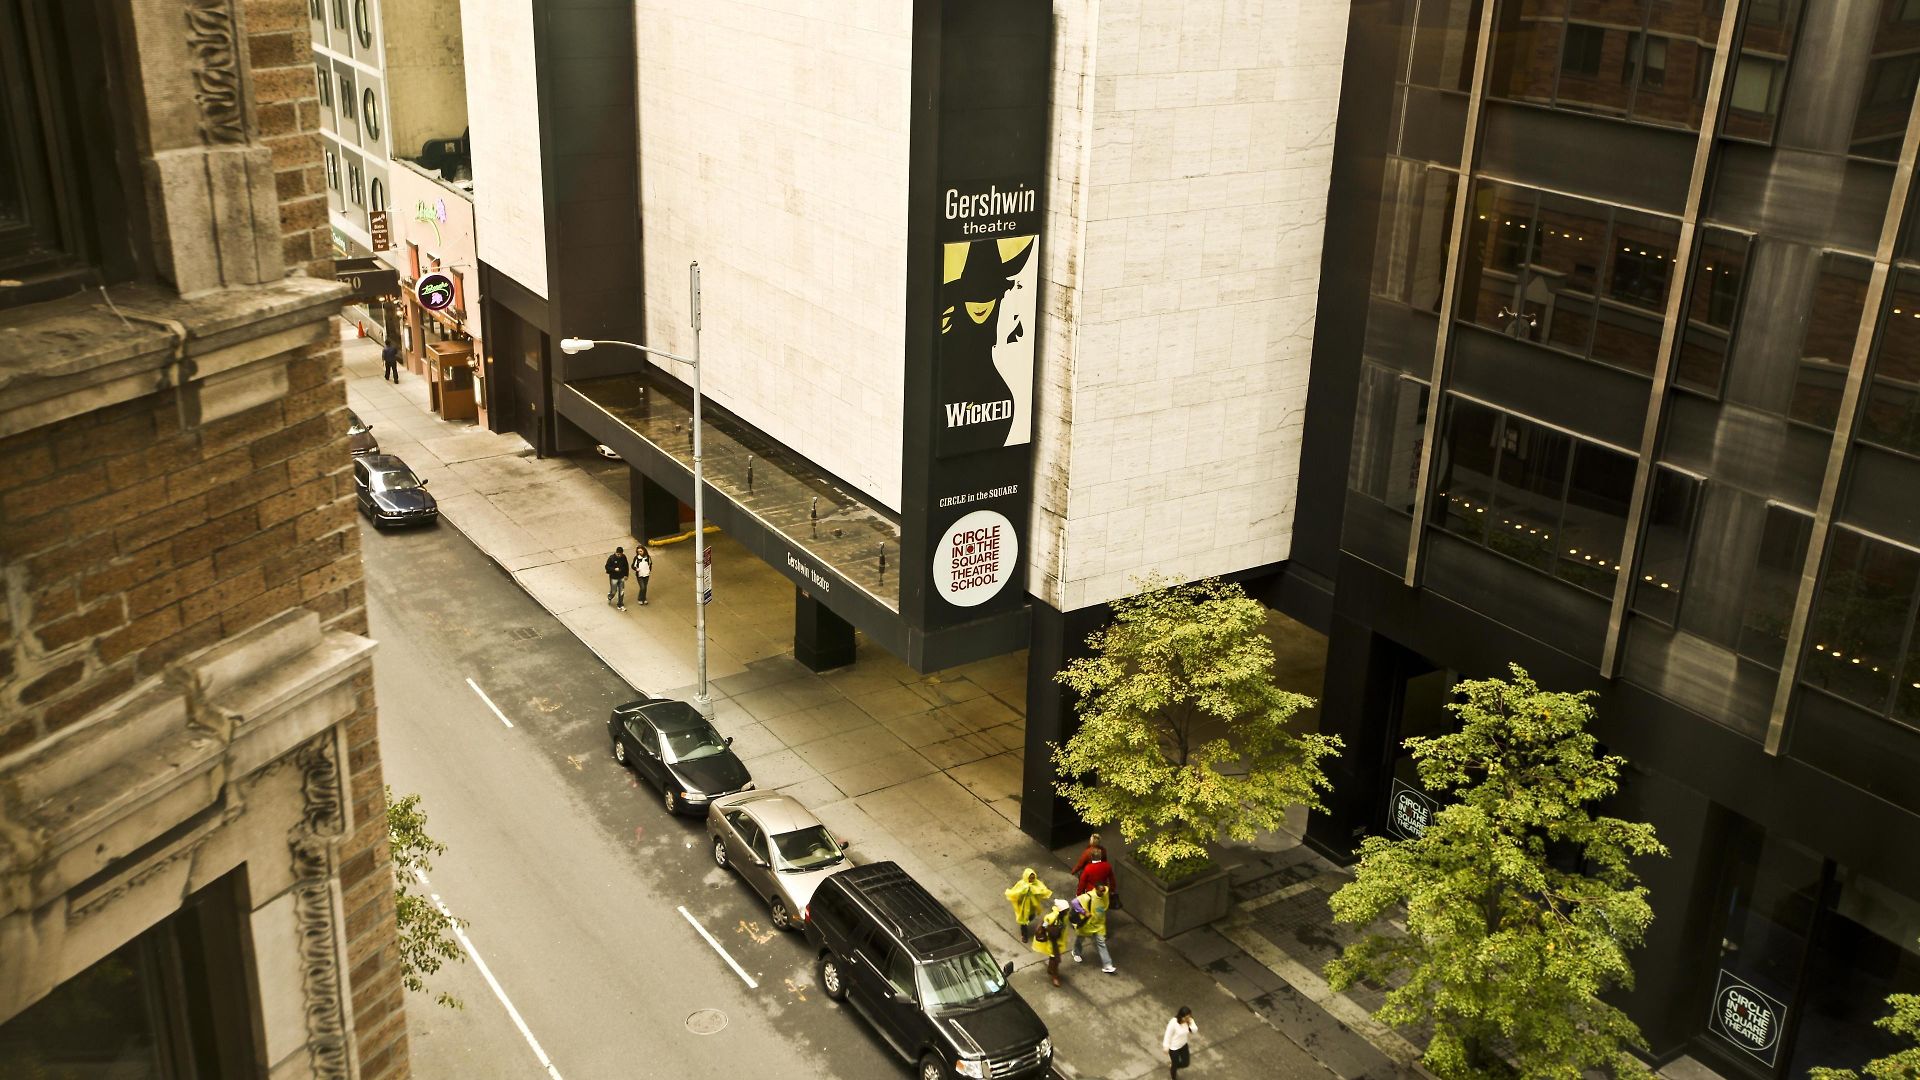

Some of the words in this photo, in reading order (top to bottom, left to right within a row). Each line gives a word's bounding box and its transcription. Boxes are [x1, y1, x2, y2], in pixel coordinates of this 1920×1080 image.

[945, 183, 1035, 220] Gershwin
[963, 219, 1017, 235] theatre
[939, 494, 967, 508] CIRCLE
[967, 493, 975, 503] in
[976, 491, 989, 501] the
[988, 484, 1018, 498] SQUARE
[952, 525, 1001, 546] CIRCLE
[951, 545, 964, 559] IN
[976, 538, 1000, 553] THE
[951, 550, 999, 569] SQUARE
[787, 551, 810, 579] Gershwin
[811, 569, 830, 593] theatre
[950, 562, 999, 581] THEATRE
[950, 573, 999, 593] SCHOOL
[1398, 802, 1407, 813] IN
[1412, 810, 1427, 825] THE
[1400, 795, 1428, 817] CIRCLE
[1726, 999, 1738, 1012] IN
[1747, 1010, 1769, 1030] THE
[1729, 990, 1770, 1022] CIRCLE
[1724, 1016, 1764, 1047] THEATRE
[1725, 1008, 1767, 1039] SQUARE
